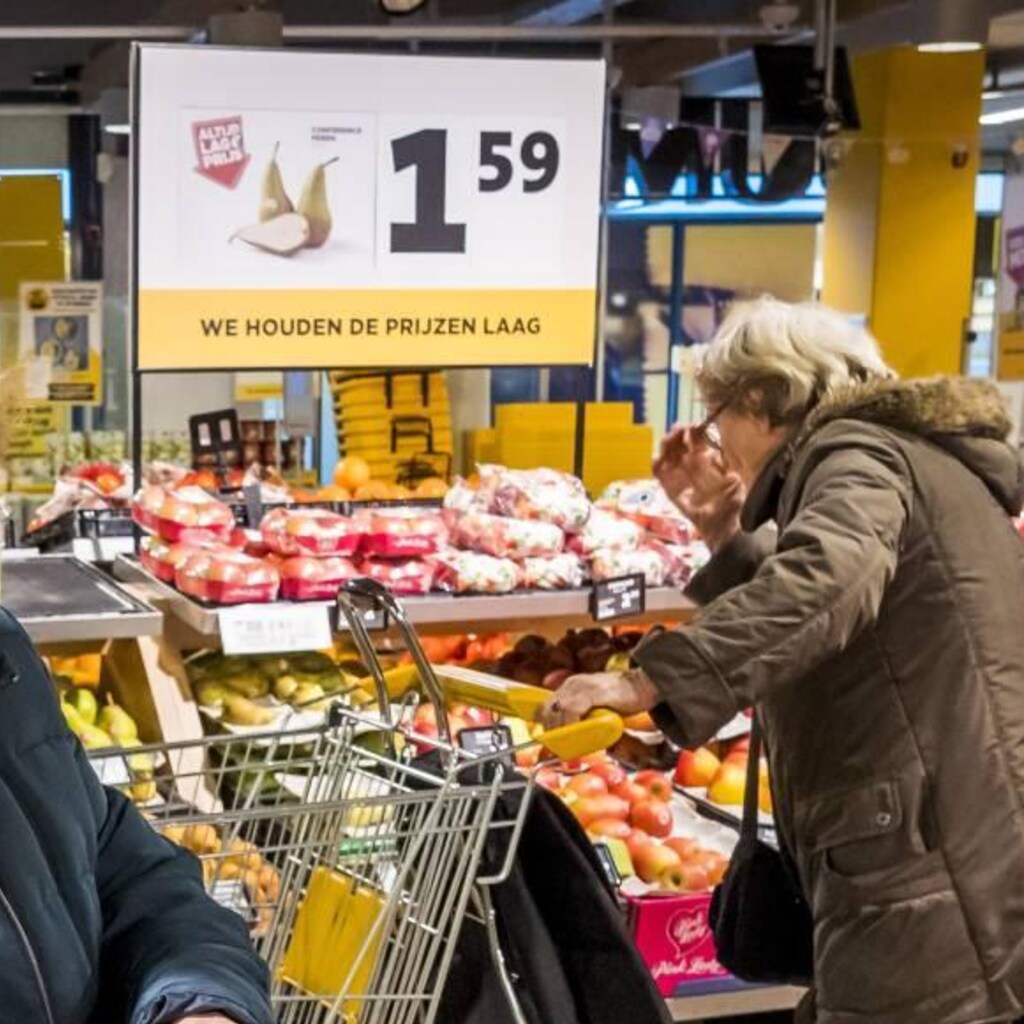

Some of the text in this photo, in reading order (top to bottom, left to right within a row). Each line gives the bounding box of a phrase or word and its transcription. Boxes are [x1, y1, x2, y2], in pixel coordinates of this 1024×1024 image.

[390, 128, 560, 253] 1 59
[200, 316, 542, 337] WE HOUDEN DE PRIJZEN LAAG
